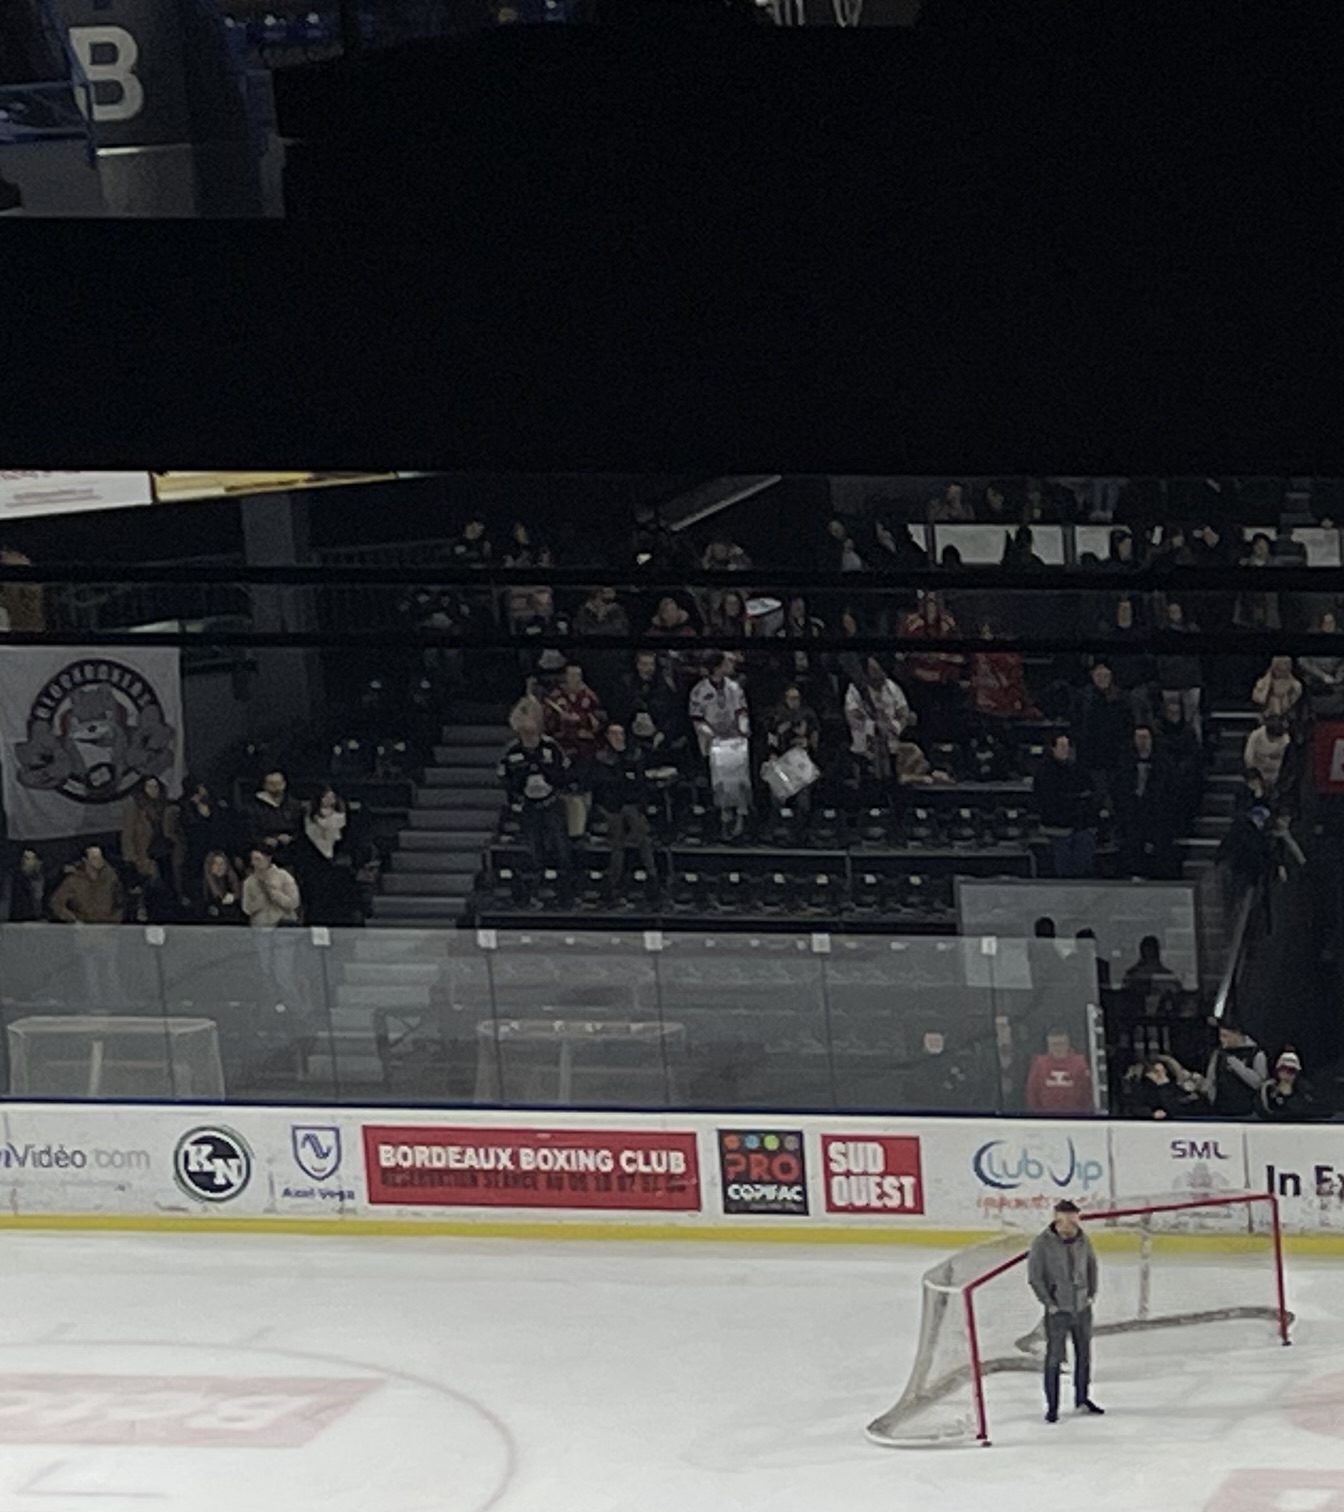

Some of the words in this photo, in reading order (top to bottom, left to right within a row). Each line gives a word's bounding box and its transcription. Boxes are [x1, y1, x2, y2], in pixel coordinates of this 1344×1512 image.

[69, 25, 144, 122] B
[378, 1144, 515, 1170] BORDEAUX
[519, 1148, 614, 1172] BOXING
[619, 1150, 687, 1174] CLUB
[723, 1152, 801, 1181] PRO
[828, 1141, 886, 1174] SUD
[830, 1175, 917, 1209] OUEST
[1265, 1163, 1302, 1197] In
